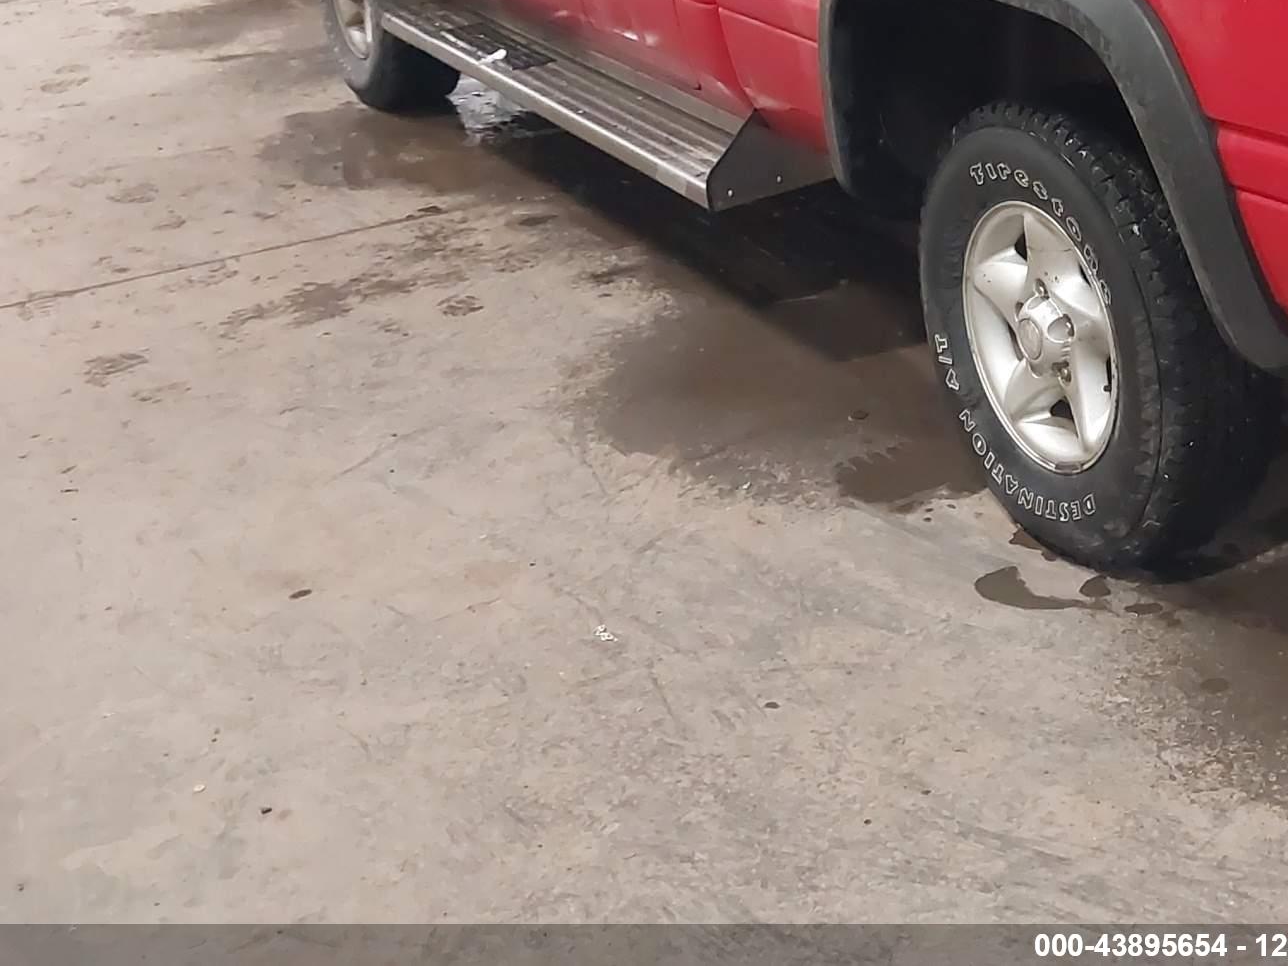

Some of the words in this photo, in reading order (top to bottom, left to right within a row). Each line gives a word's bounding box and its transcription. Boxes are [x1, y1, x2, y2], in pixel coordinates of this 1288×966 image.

[970, 162, 1111, 305] Firestone
[935, 334, 959, 391] A/T
[960, 409, 1096, 522] DESTINATION
